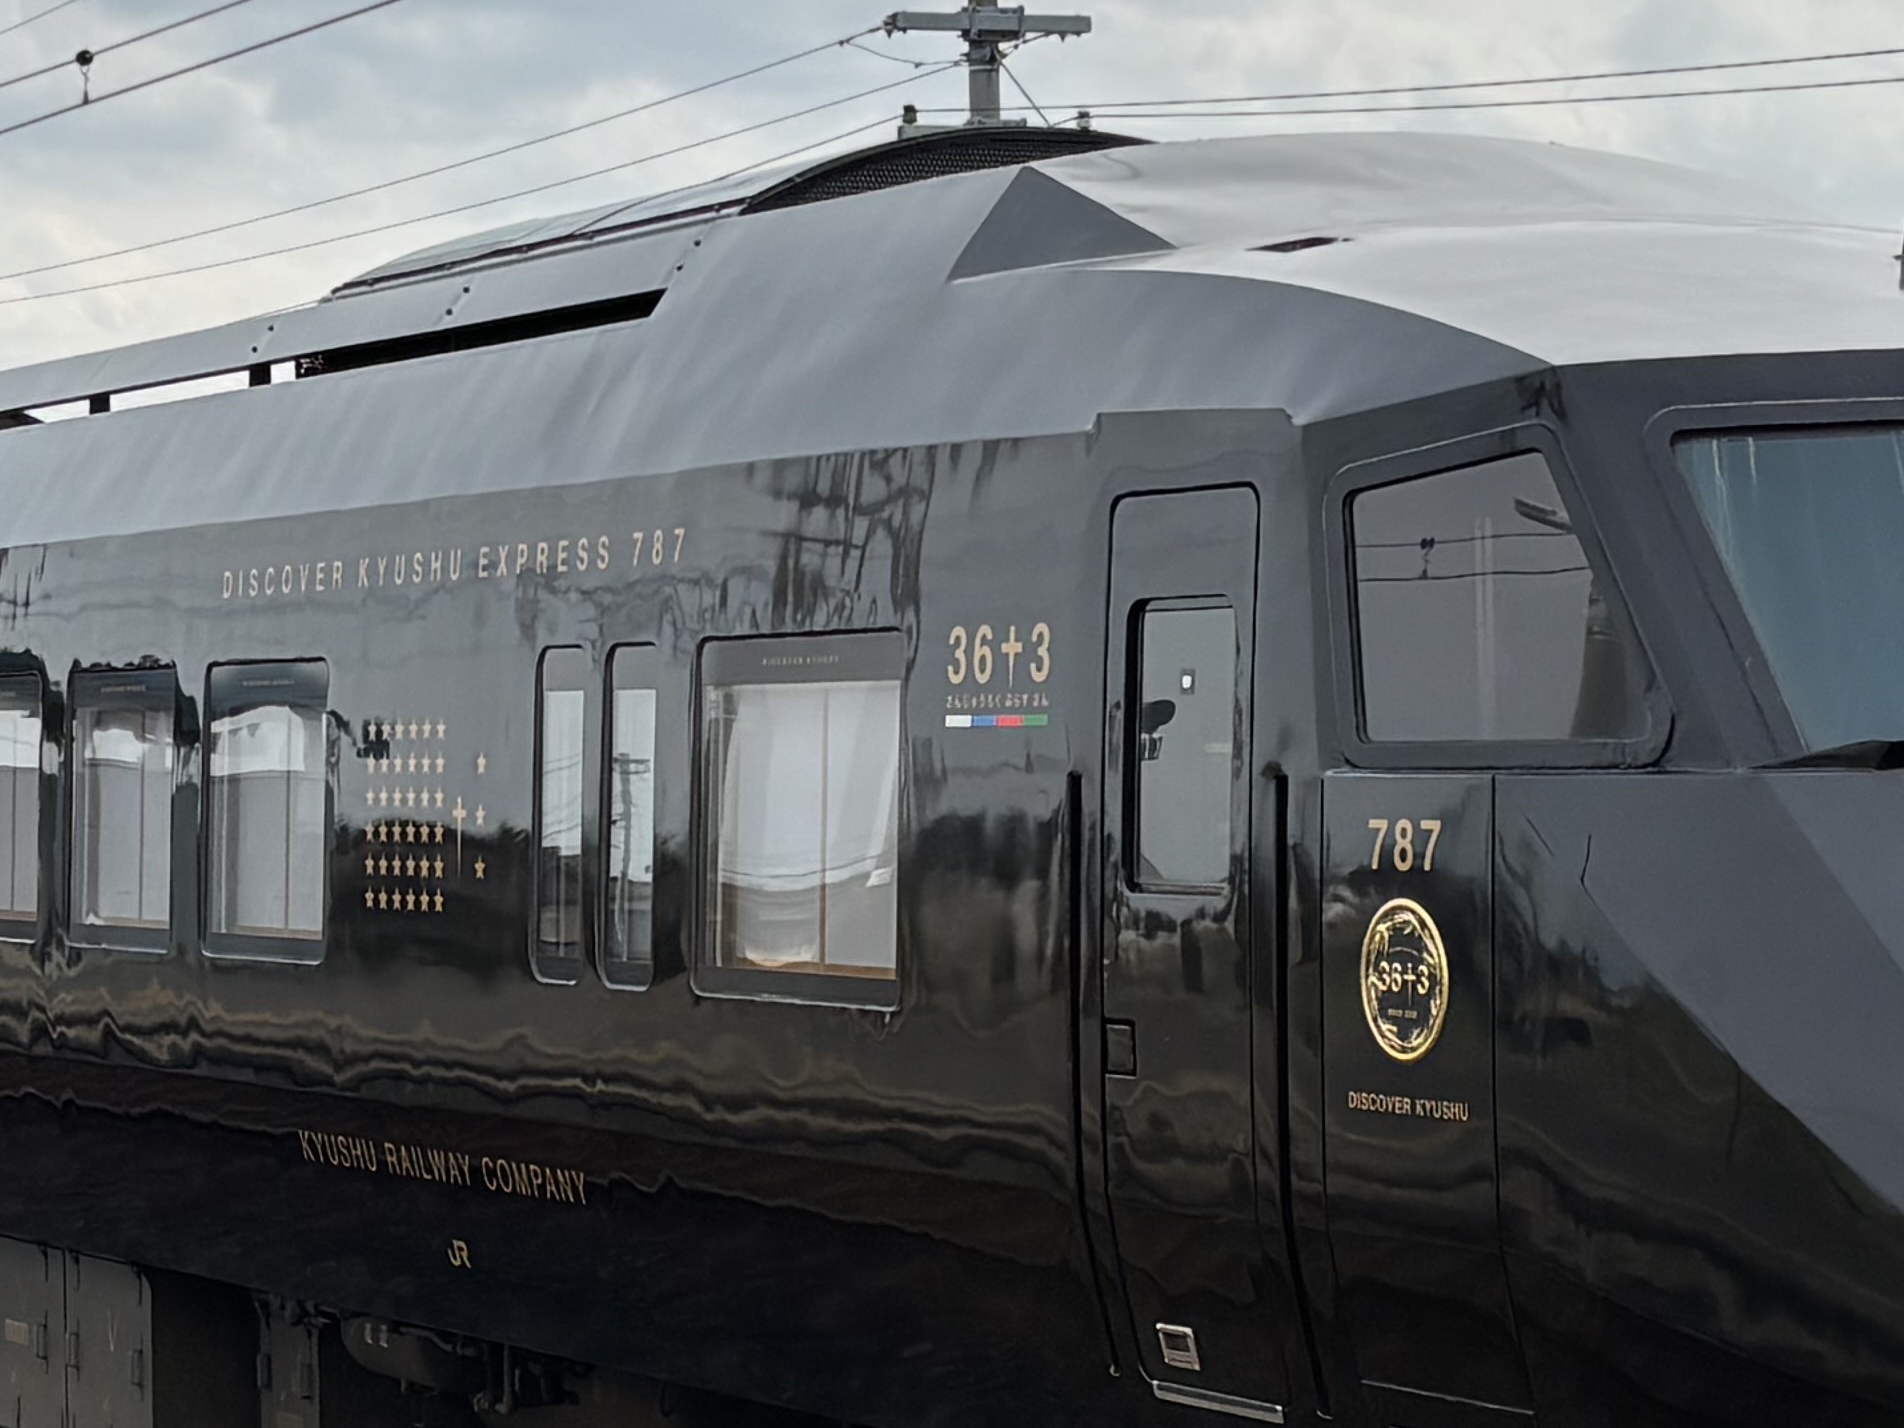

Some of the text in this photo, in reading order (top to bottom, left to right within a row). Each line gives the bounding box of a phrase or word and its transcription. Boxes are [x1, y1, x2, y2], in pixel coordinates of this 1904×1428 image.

[222, 527, 687, 600] DISCOVER KYUSHU EXPRESS 787
[947, 622, 1051, 689] 36+3
[1367, 818, 1442, 872] 787
[1348, 1090, 1470, 1122] DISCOVER KYUSHU
[298, 1130, 587, 1205] KYUSHU RAILWAY COMPANY
[448, 1239, 472, 1269] JR
